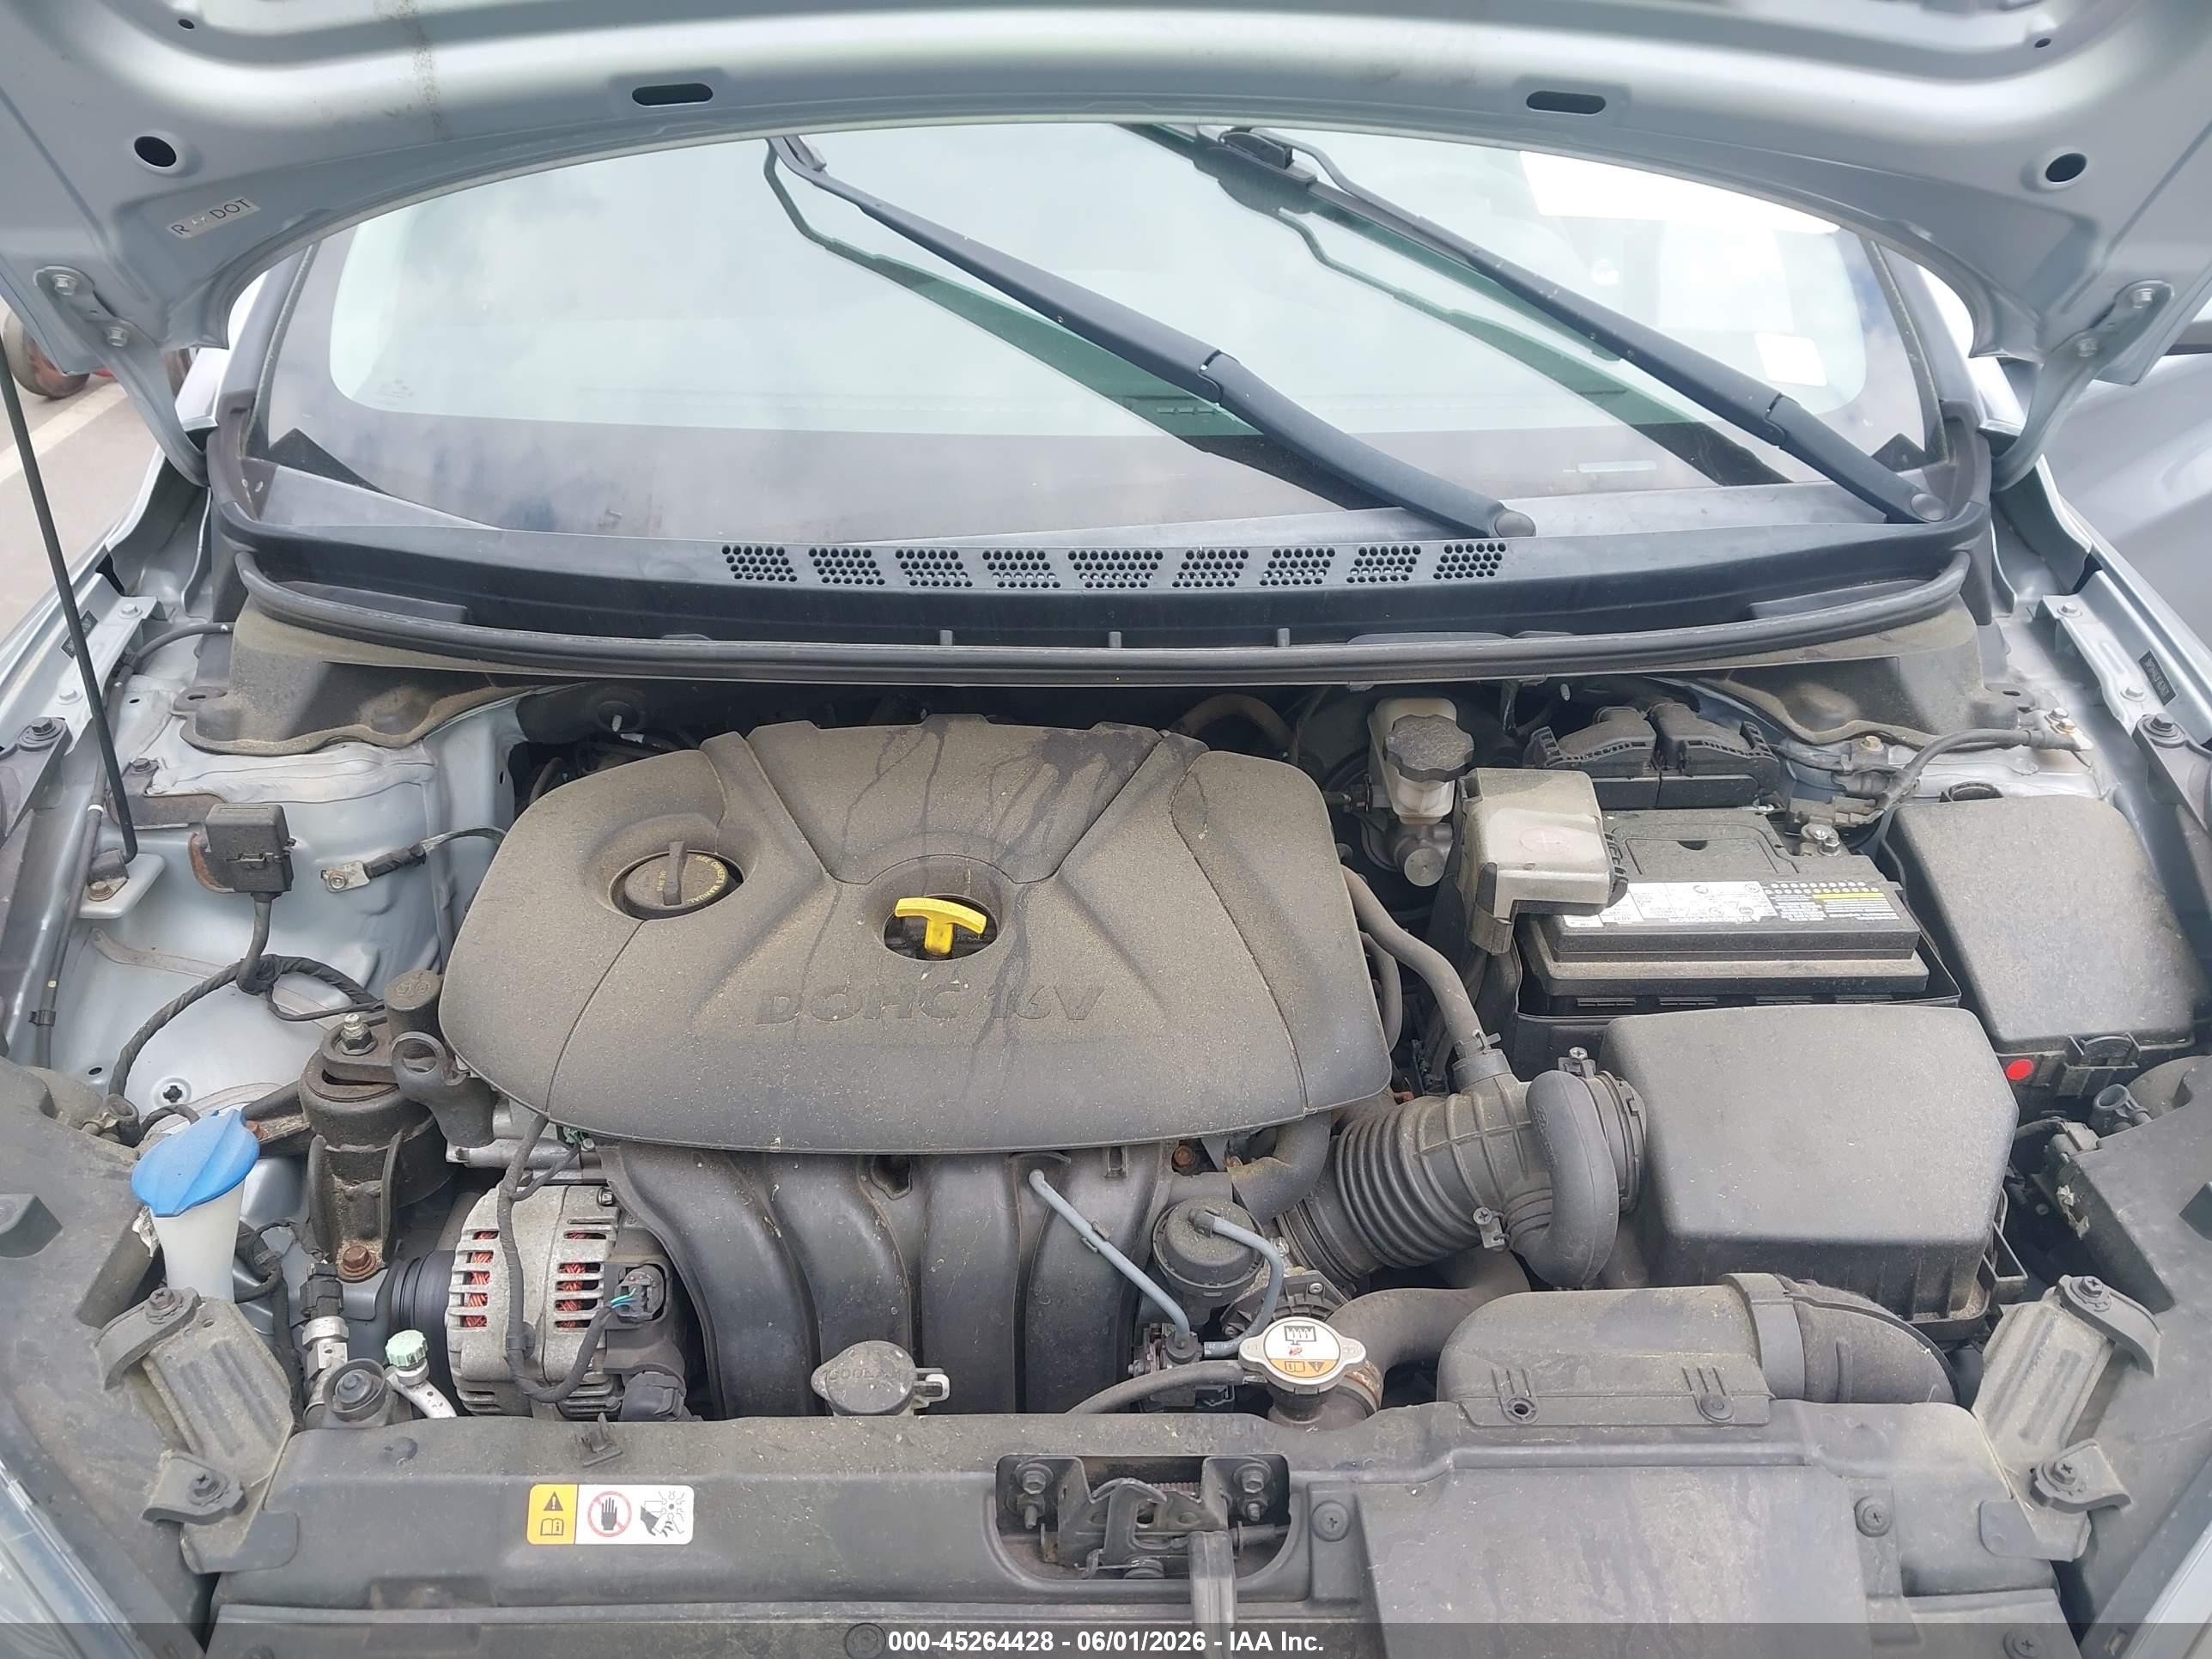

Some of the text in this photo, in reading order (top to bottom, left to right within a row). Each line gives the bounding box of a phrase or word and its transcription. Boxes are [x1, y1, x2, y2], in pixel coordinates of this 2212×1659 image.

[209, 198, 251, 219] DOT
[694, 854, 712, 864] SEE
[687, 884, 720, 904] MANUAL
[755, 982, 1105, 1025] DOHC 16V
